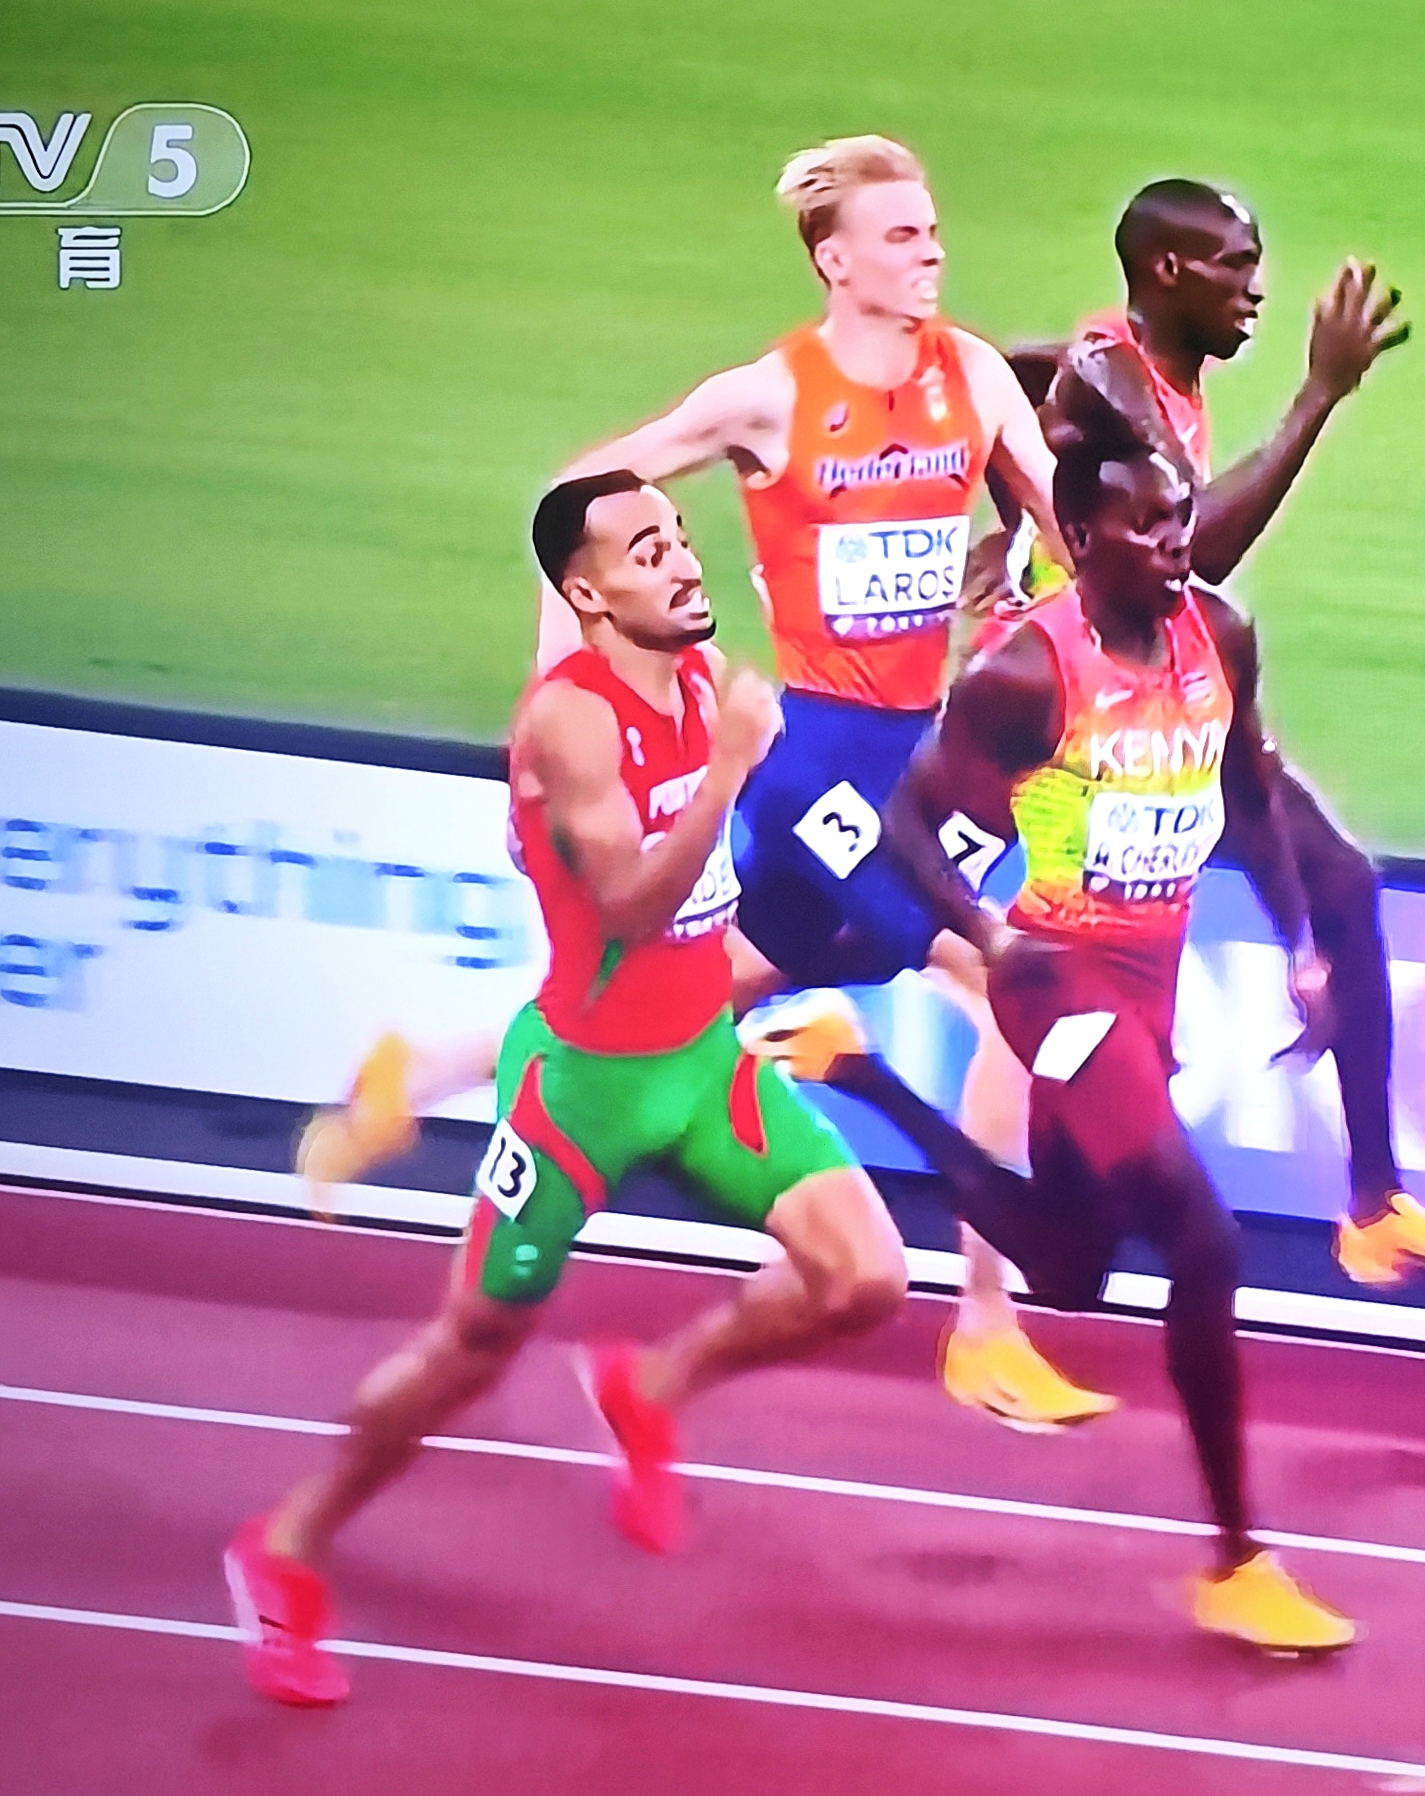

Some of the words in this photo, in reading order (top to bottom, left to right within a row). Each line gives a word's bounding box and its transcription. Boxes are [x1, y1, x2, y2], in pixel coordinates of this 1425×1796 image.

[868, 525, 959, 559] TDK
[835, 564, 956, 607] LAROS
[822, 811, 862, 853] 3
[1142, 798, 1215, 837] TDK
[488, 1136, 527, 1199] 13
